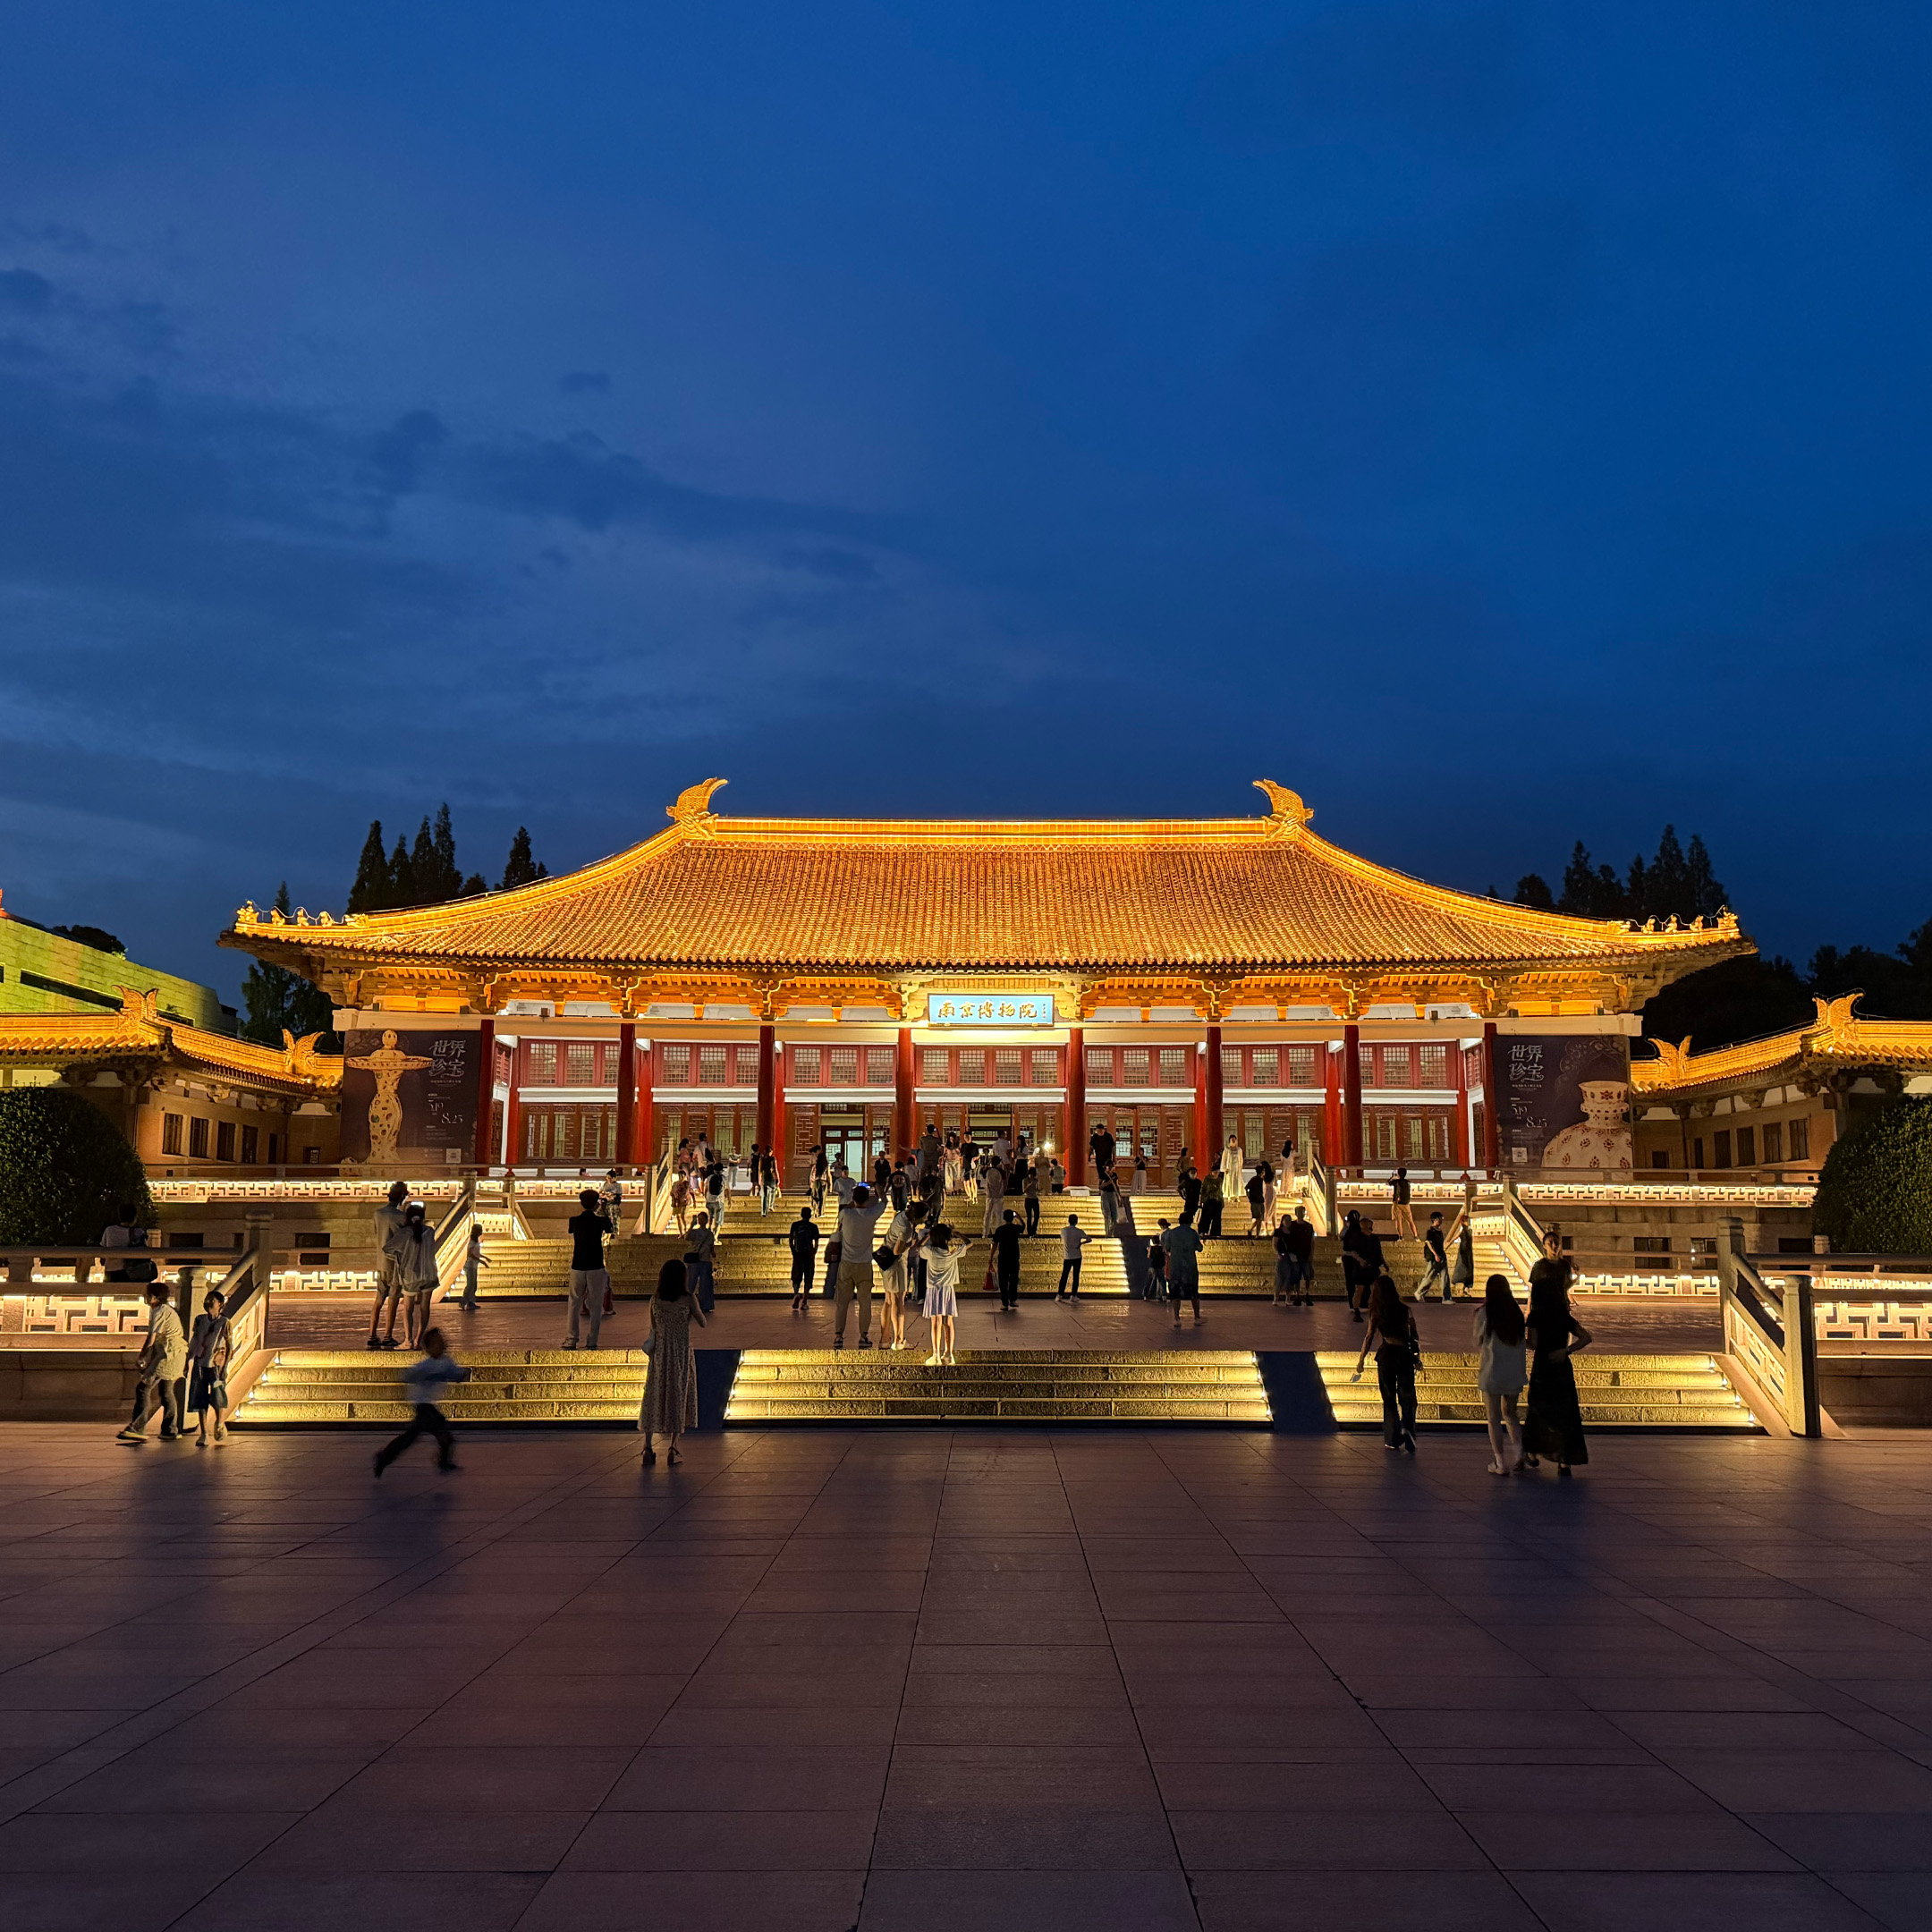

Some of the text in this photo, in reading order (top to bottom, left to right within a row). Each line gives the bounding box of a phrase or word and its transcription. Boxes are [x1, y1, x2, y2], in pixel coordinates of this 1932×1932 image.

[938, 1001, 1038, 1019] 南京博物院
[429, 1040, 466, 1058] 世界
[1508, 1045, 1543, 1063] 世界
[429, 1059, 466, 1078] 珍宝
[1509, 1063, 1545, 1082] 珍宝
[1526, 1116, 1548, 1128] 8.25
